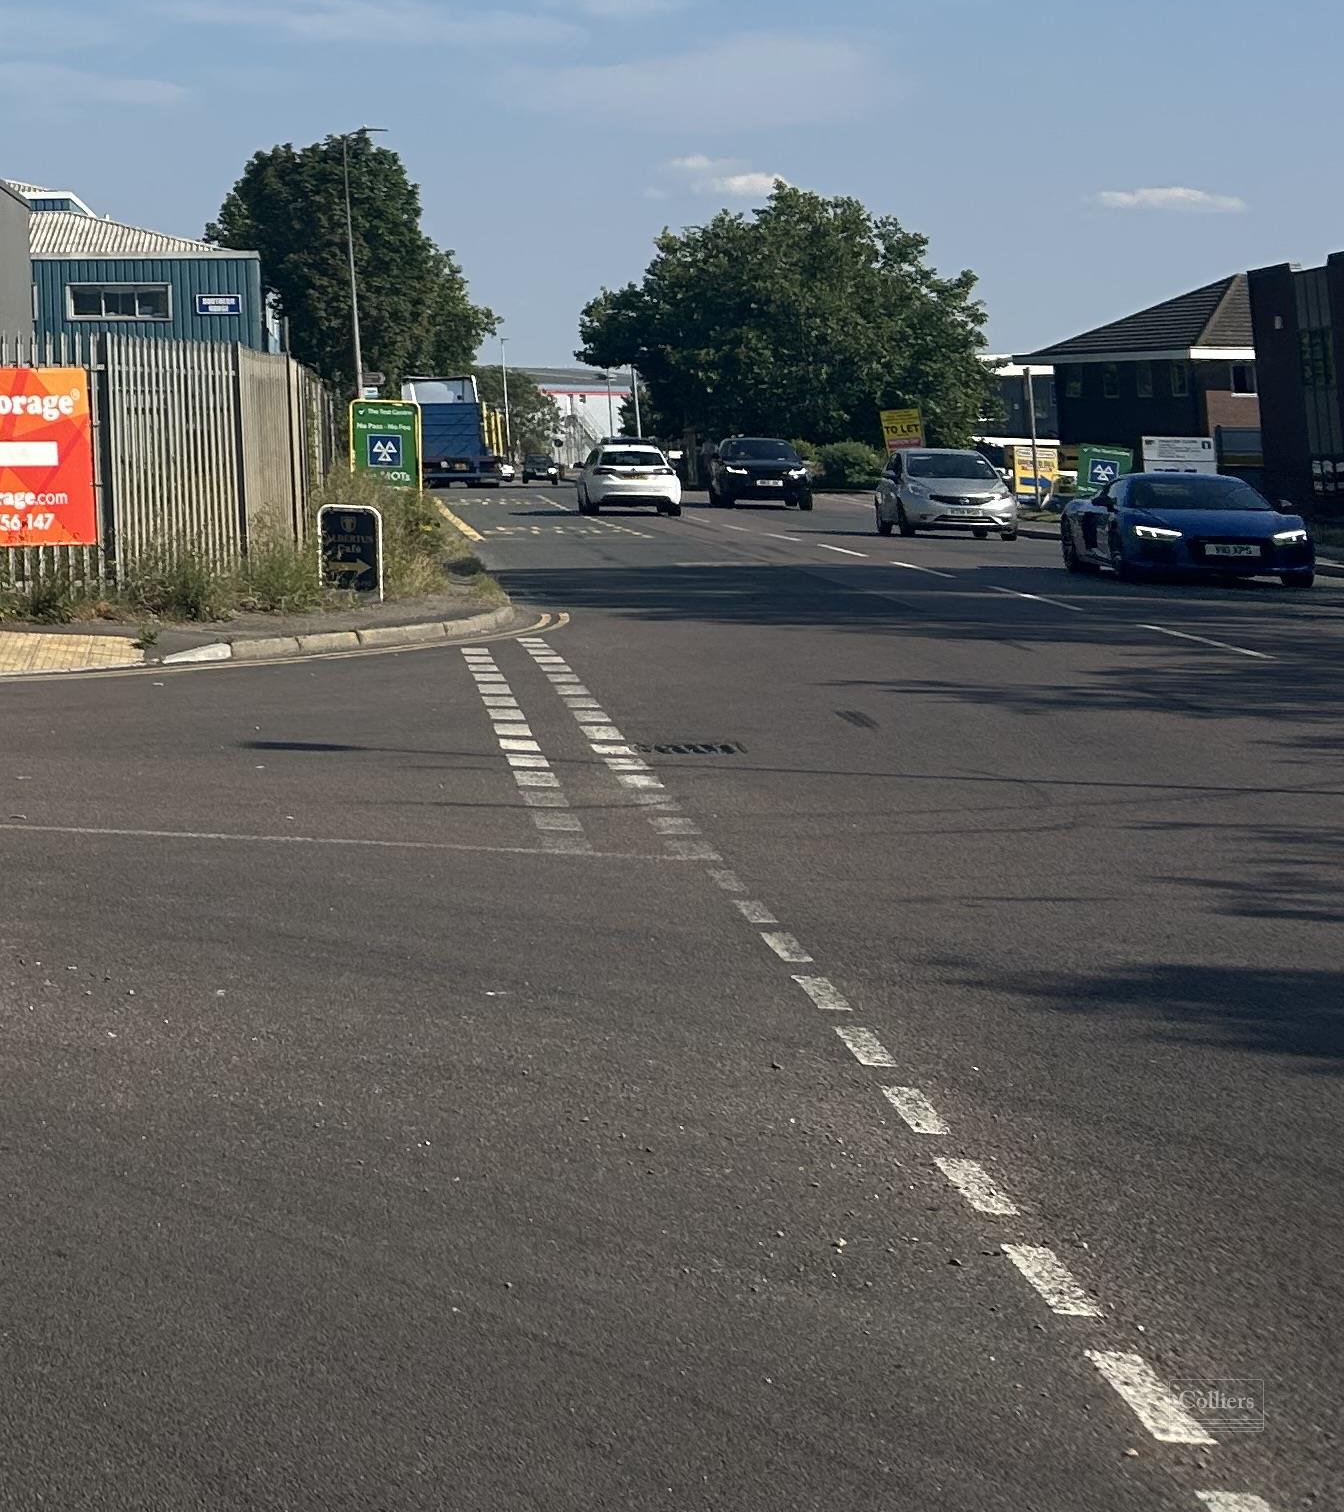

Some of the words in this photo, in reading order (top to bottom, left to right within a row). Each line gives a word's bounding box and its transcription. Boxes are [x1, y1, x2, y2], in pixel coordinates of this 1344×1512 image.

[884, 425, 898, 435] TO
[900, 423, 919, 433] LET
[26, 513, 55, 530] 147
